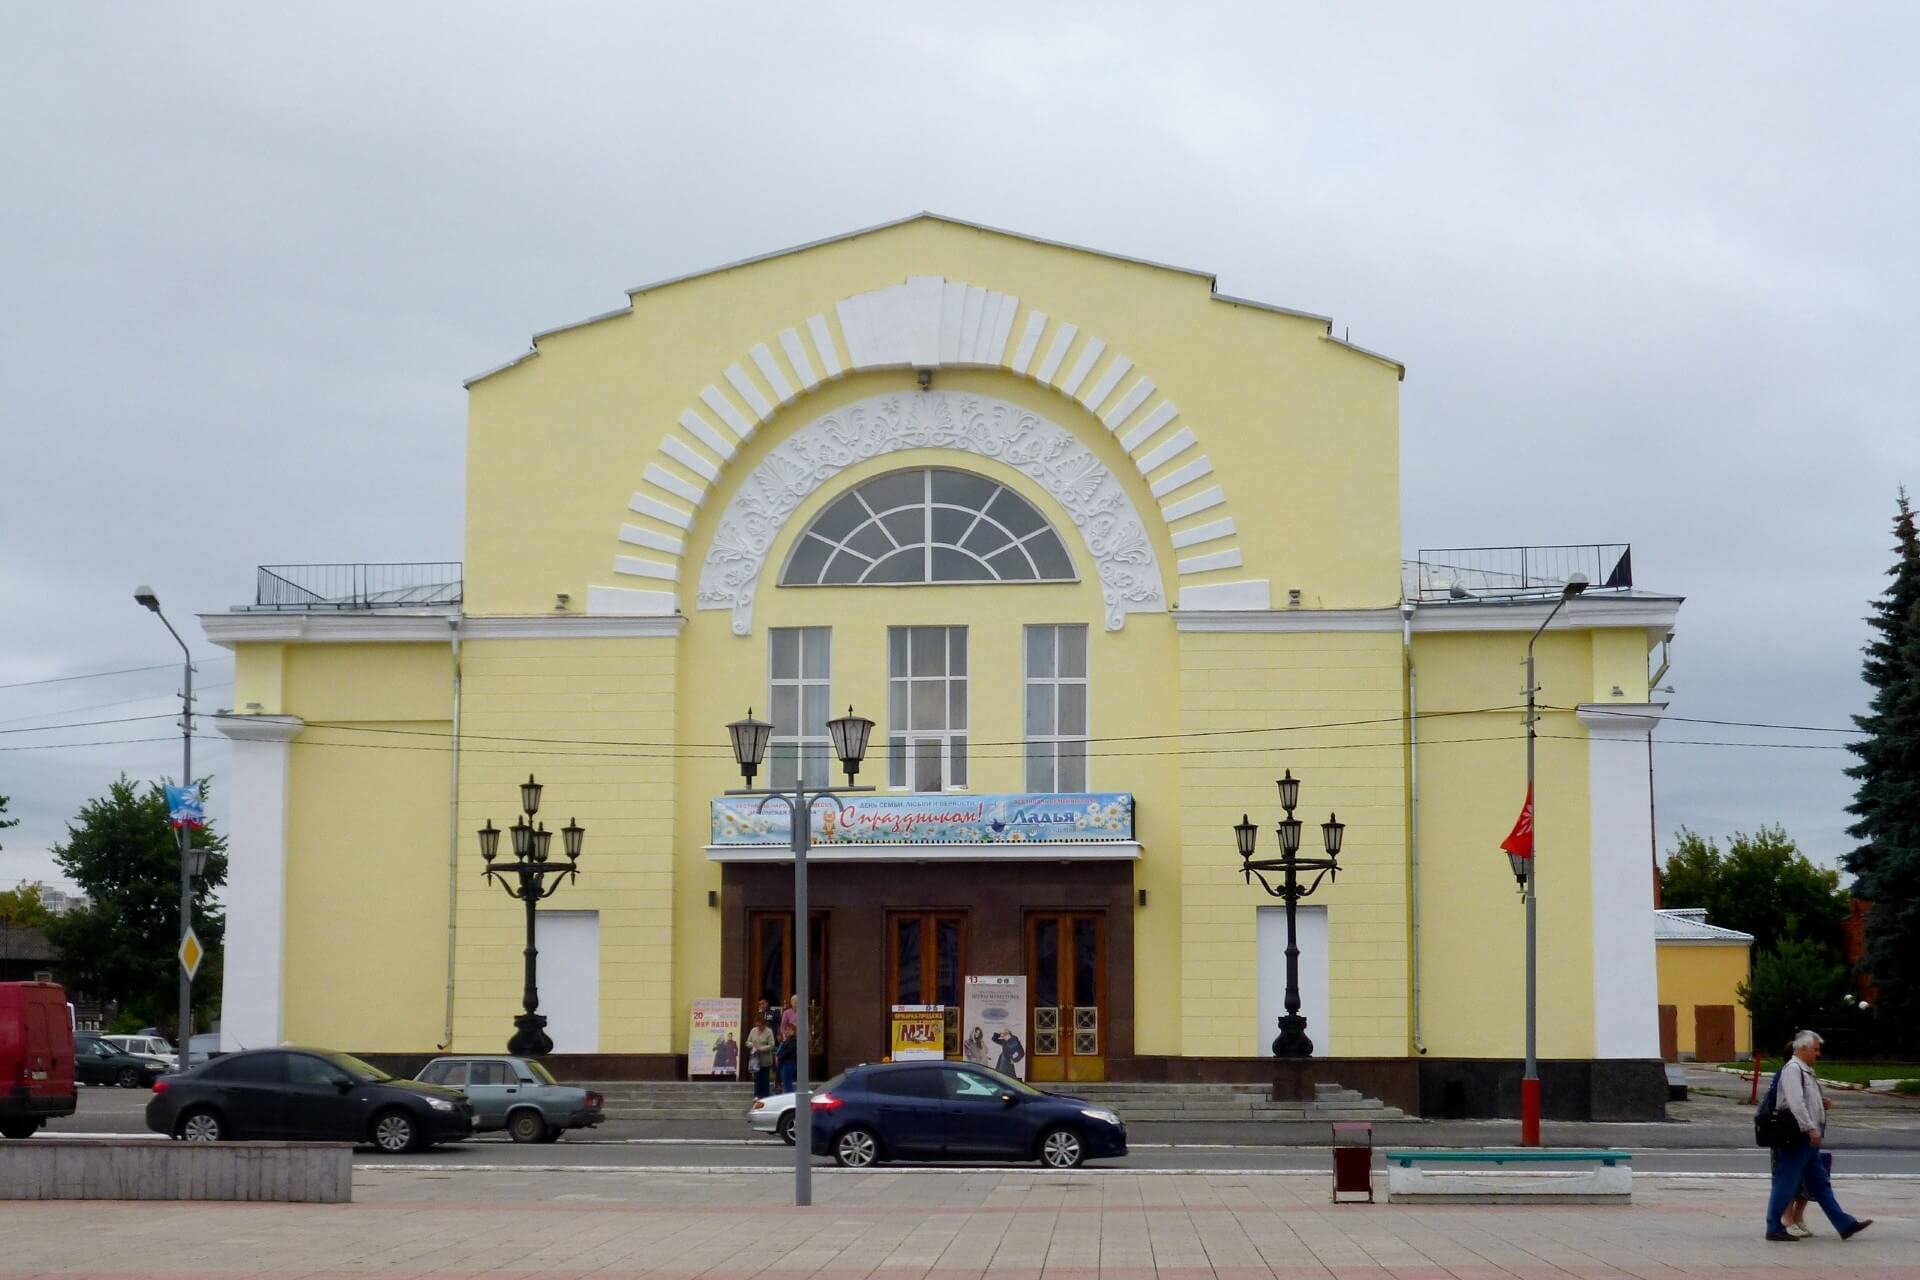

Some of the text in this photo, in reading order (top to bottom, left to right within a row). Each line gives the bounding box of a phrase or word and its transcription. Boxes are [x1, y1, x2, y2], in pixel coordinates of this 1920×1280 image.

[840, 802, 984, 832] С праздником!
[1010, 809, 1075, 824] Ладья
[694, 1011, 704, 1020] 20
